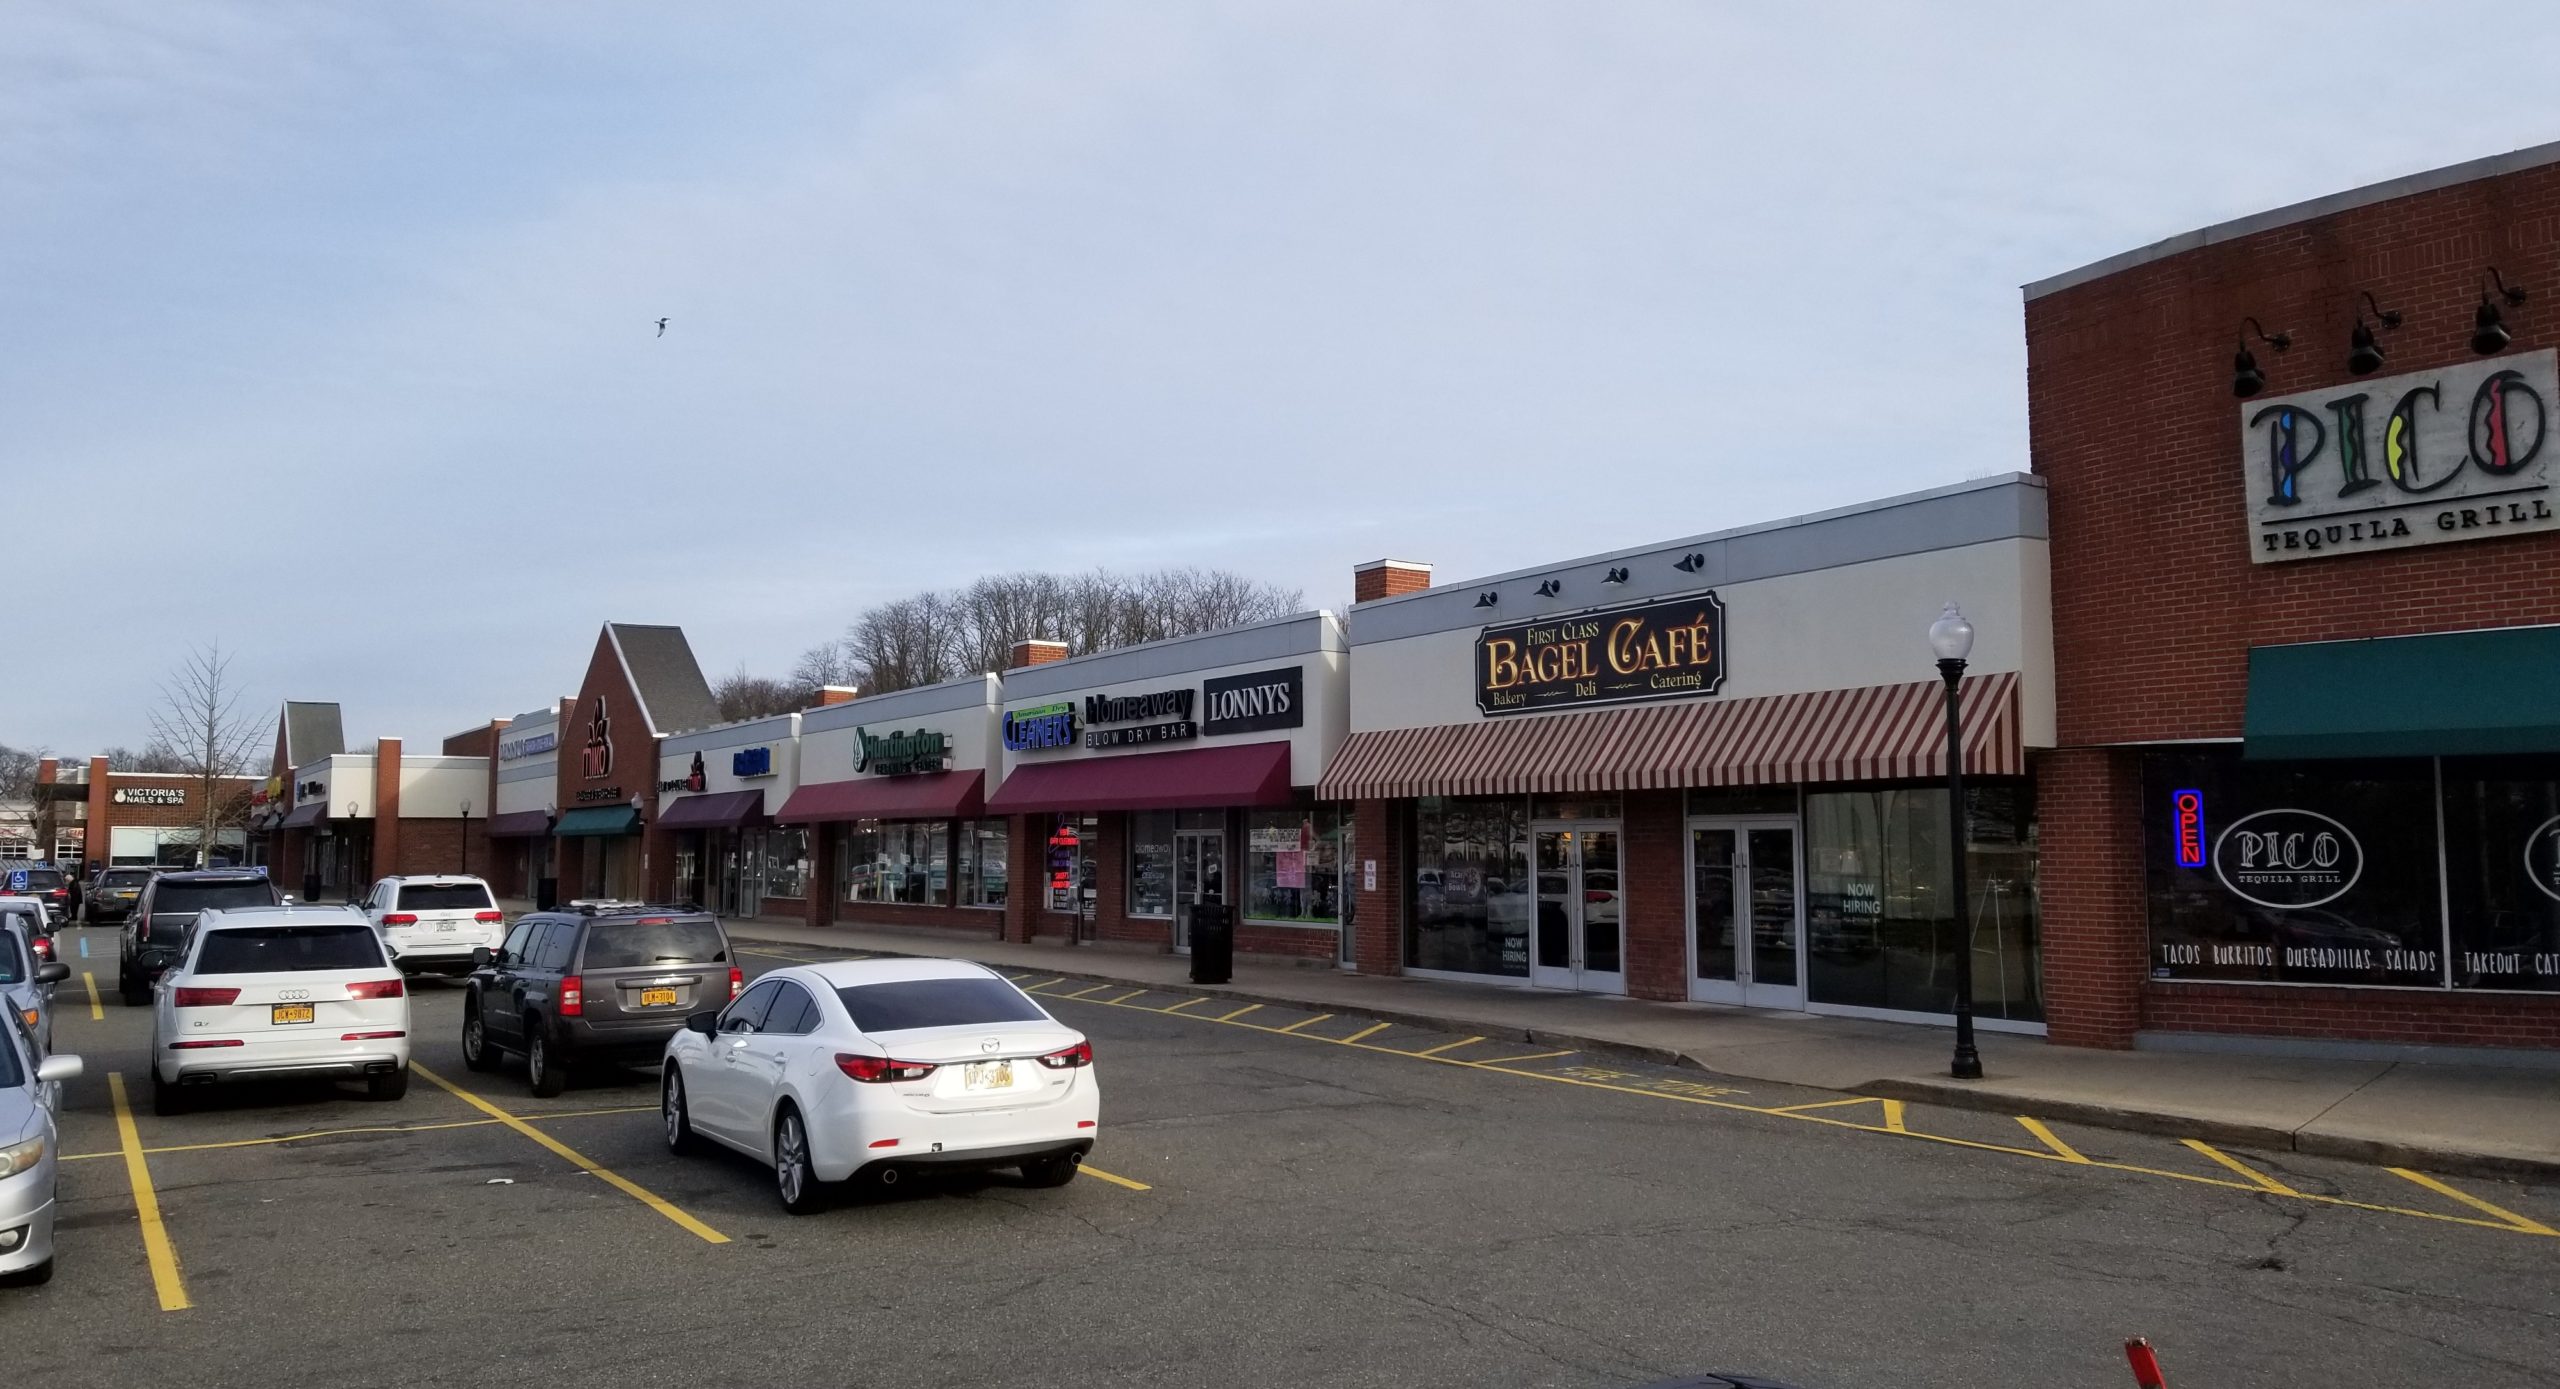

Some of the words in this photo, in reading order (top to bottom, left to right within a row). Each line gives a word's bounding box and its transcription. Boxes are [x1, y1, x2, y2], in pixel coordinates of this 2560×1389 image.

[2250, 369, 2546, 507] PICO
[2263, 517, 2411, 552] TEQUILA
[2437, 500, 2552, 531] GRILL
[1527, 627, 1557, 646] FIRST
[1562, 621, 1599, 641] CLASS
[1485, 637, 1599, 690] BAGEL
[1607, 612, 1712, 675] CAFÉ
[1209, 682, 1291, 722] LONNYS
[1493, 691, 1527, 707] Bakery
[1575, 682, 1597, 697] Deli
[1650, 672, 1702, 690] Catering
[1002, 711, 1071, 751] CLEANERS
[1087, 733, 1119, 746] BLOW
[1128, 728, 1151, 743] DRY
[1161, 723, 1187, 739] BAR
[864, 731, 942, 763] Huntington
[126, 796, 154, 804] NAILS
[156, 796, 164, 804] &
[166, 796, 184, 804] SPA
[127, 788, 185, 797] VICTORIA'S
[2178, 793, 2200, 864] OPEN
[2235, 831, 2339, 869] PICO
[1847, 883, 1875, 897] NOW
[2238, 874, 2293, 884] TEQUILA
[2301, 874, 2341, 883] GRILL
[1843, 899, 1881, 914] HIRING
[1504, 937, 1523, 948] NOW
[1502, 950, 1527, 962] HIRING
[2163, 944, 2200, 965] TACOS
[2214, 945, 2273, 966] BURRITOS
[2287, 948, 2370, 970] QUESADILLAS
[2386, 949, 2436, 972] SALADS
[2465, 951, 2520, 974] TAKEOUT
